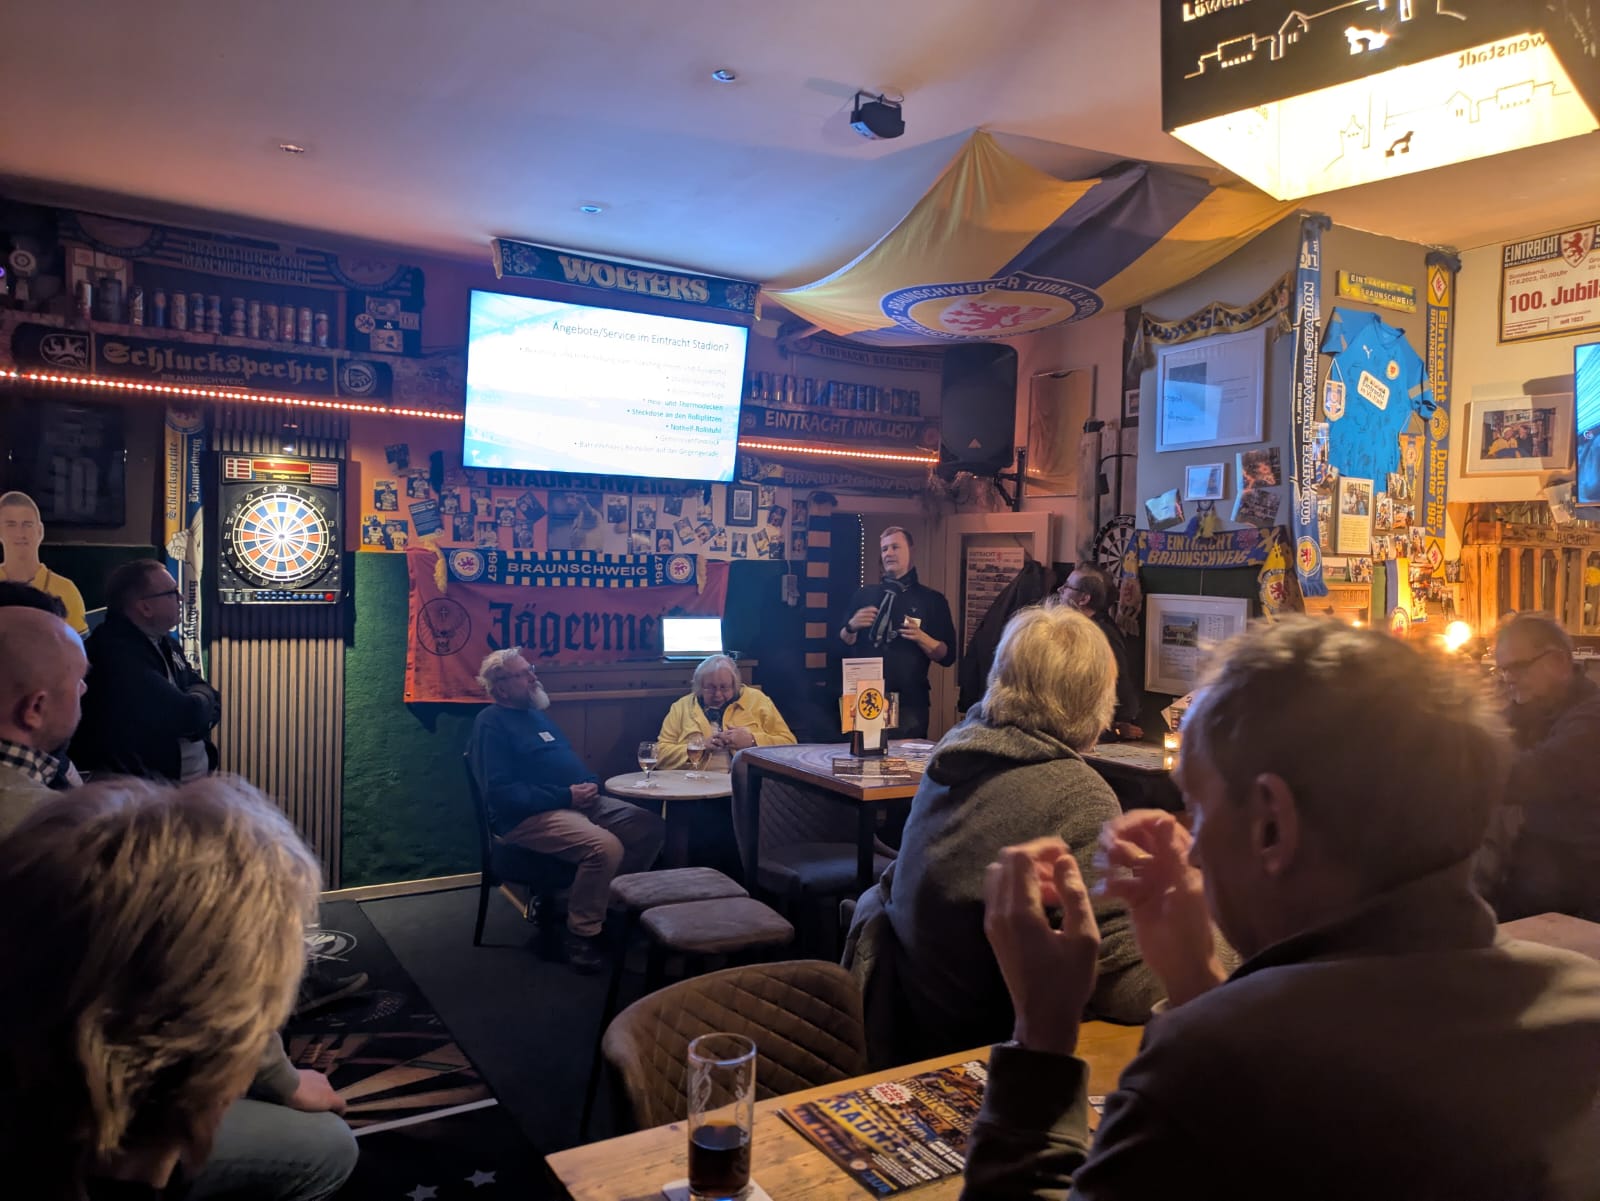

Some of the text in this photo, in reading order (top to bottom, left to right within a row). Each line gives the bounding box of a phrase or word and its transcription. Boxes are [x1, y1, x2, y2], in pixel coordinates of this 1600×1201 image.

[1183, 0, 1253, 22] Löwen
[1504, 235, 1560, 263] EINTRACHT
[558, 256, 710, 303] WOLTERS
[1510, 279, 1600, 314] 100. Jubil
[552, 321, 730, 353] Angebote/Service im Eintracht Stadion?
[1428, 308, 1438, 390] BRAUNSCHW
[103, 341, 329, 384] Schluckspechte
[1436, 309, 1449, 402] Eintracht
[161, 373, 246, 387] BRAUNSCHWEIG
[765, 410, 917, 439] EINTRACHT INKLUSIV
[166, 440, 179, 521] Schluckspechte
[188, 437, 201, 504] Braunschweig
[1301, 446, 1313, 493] JAHRE
[1426, 440, 1438, 534] Meister 1967
[1435, 448, 1449, 530] Deutscher
[1300, 498, 1311, 526] 100
[488, 552, 499, 582] 1967
[507, 562, 648, 577] BRAUNSCHWEIG
[655, 556, 664, 584] 1967
[1147, 549, 1250, 566] BRAUNSCHWEIG
[487, 601, 687, 657] Jägermei
[875, 1085, 897, 1104] BACK
[885, 1083, 907, 1102] CASH
